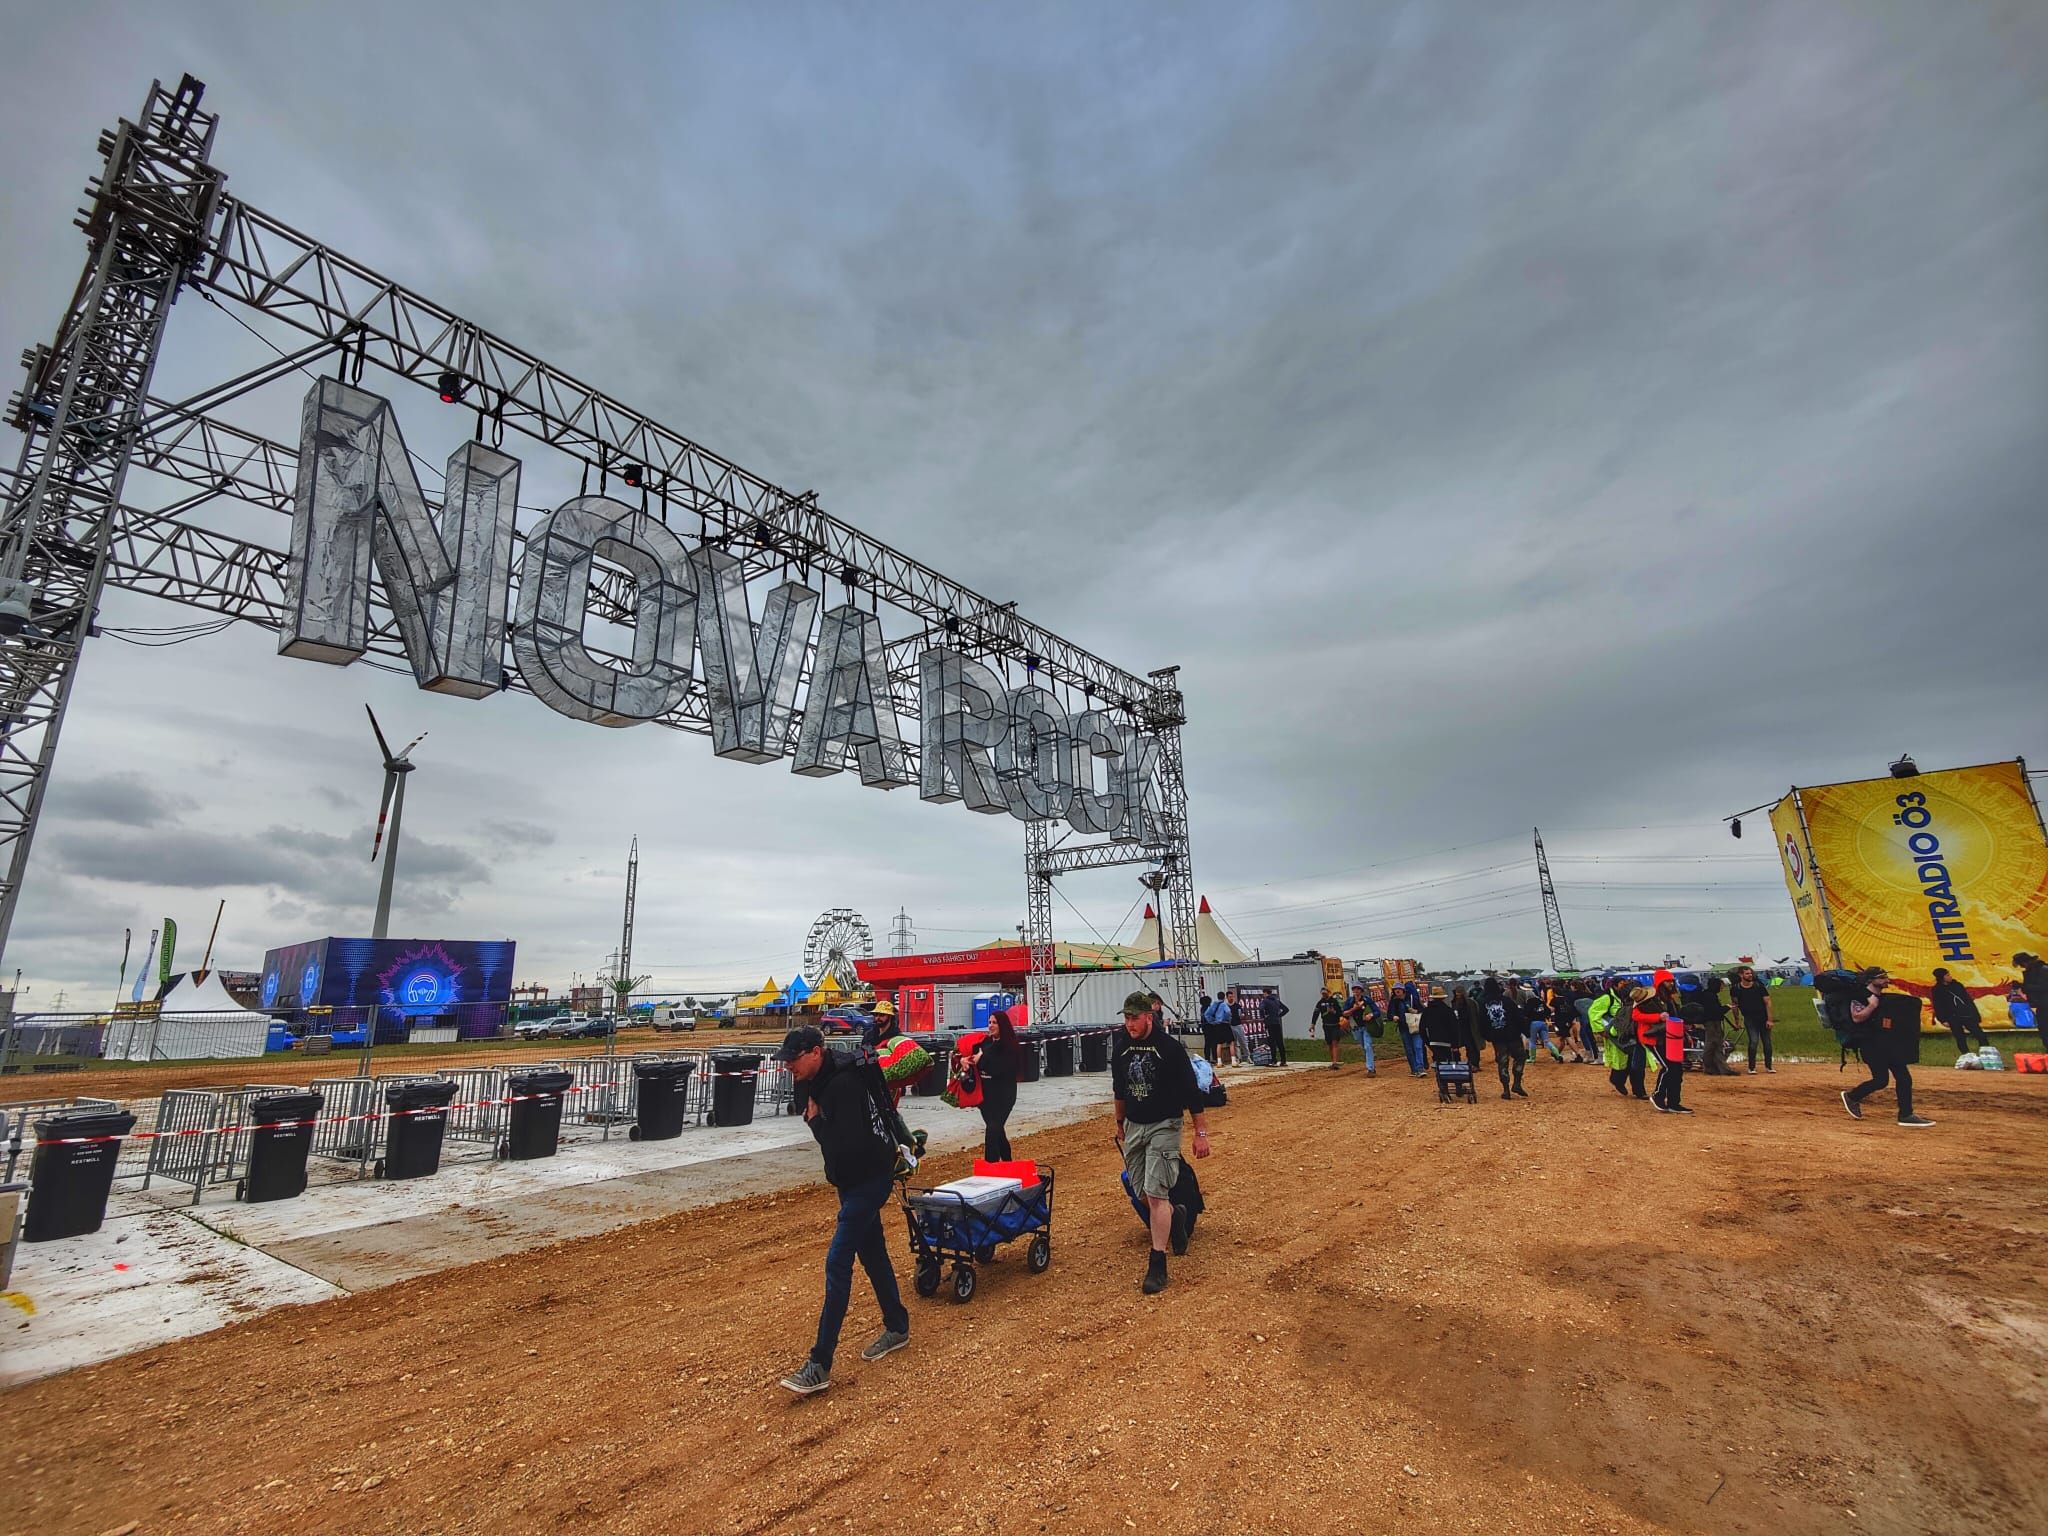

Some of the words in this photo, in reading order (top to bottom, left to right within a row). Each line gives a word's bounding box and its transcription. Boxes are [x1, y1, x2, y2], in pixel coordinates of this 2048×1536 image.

[278, 374, 909, 790] NOVA
[919, 646, 1170, 849] ROCK
[1892, 791, 1932, 829] Ö3
[1908, 832, 1975, 962] HITRADIO
